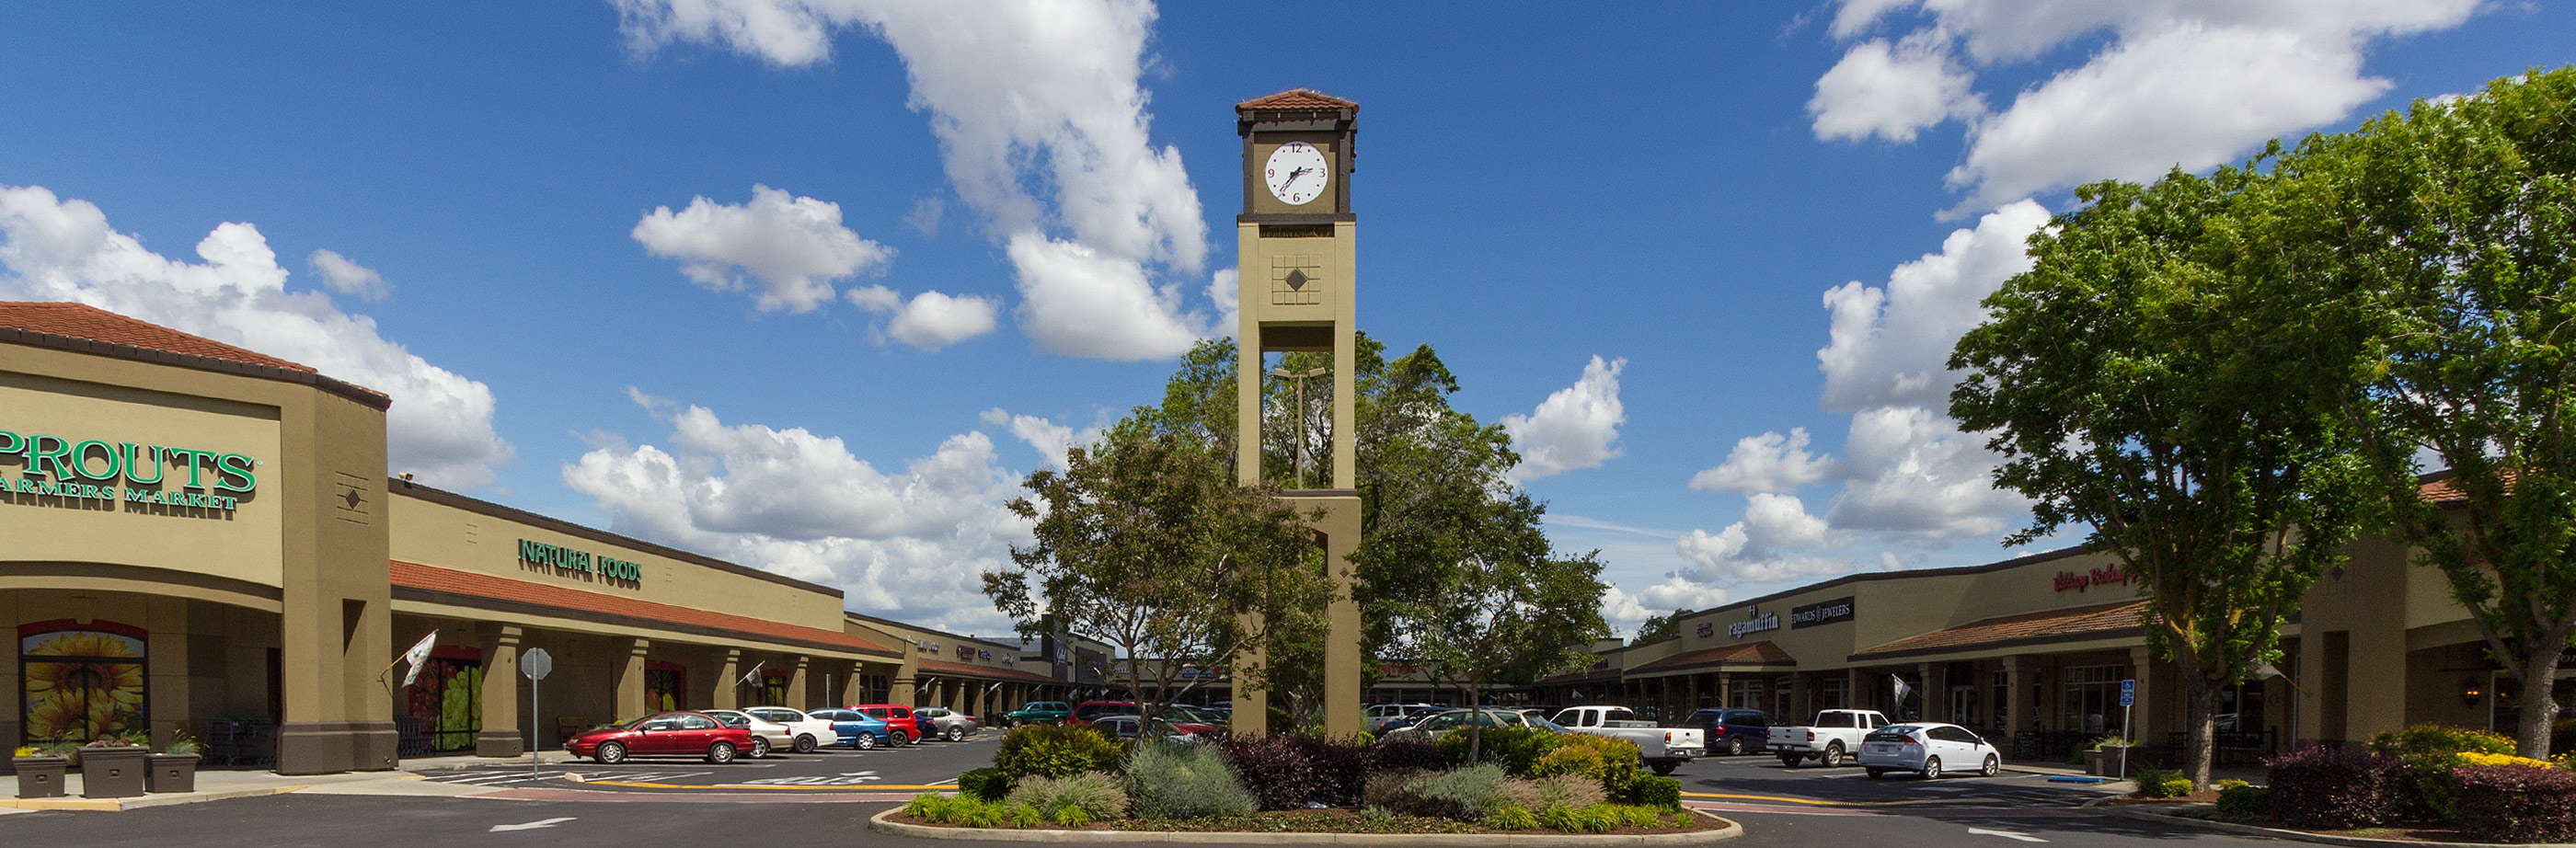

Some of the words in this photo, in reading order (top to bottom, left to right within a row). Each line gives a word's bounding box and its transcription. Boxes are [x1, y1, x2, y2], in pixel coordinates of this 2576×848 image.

[1291, 143, 1303, 154] 12
[1268, 168, 1275, 178] 9
[1319, 168, 1326, 178] 3
[1293, 192, 1300, 202] 6
[124, 487, 238, 510] MARKET
[520, 538, 595, 573] NATURAL
[600, 556, 642, 582] FOODS
[1790, 610, 1816, 625] EDWARDS
[1822, 603, 1850, 621] JEWELERS
[1729, 611, 1778, 638] ragamuffin
